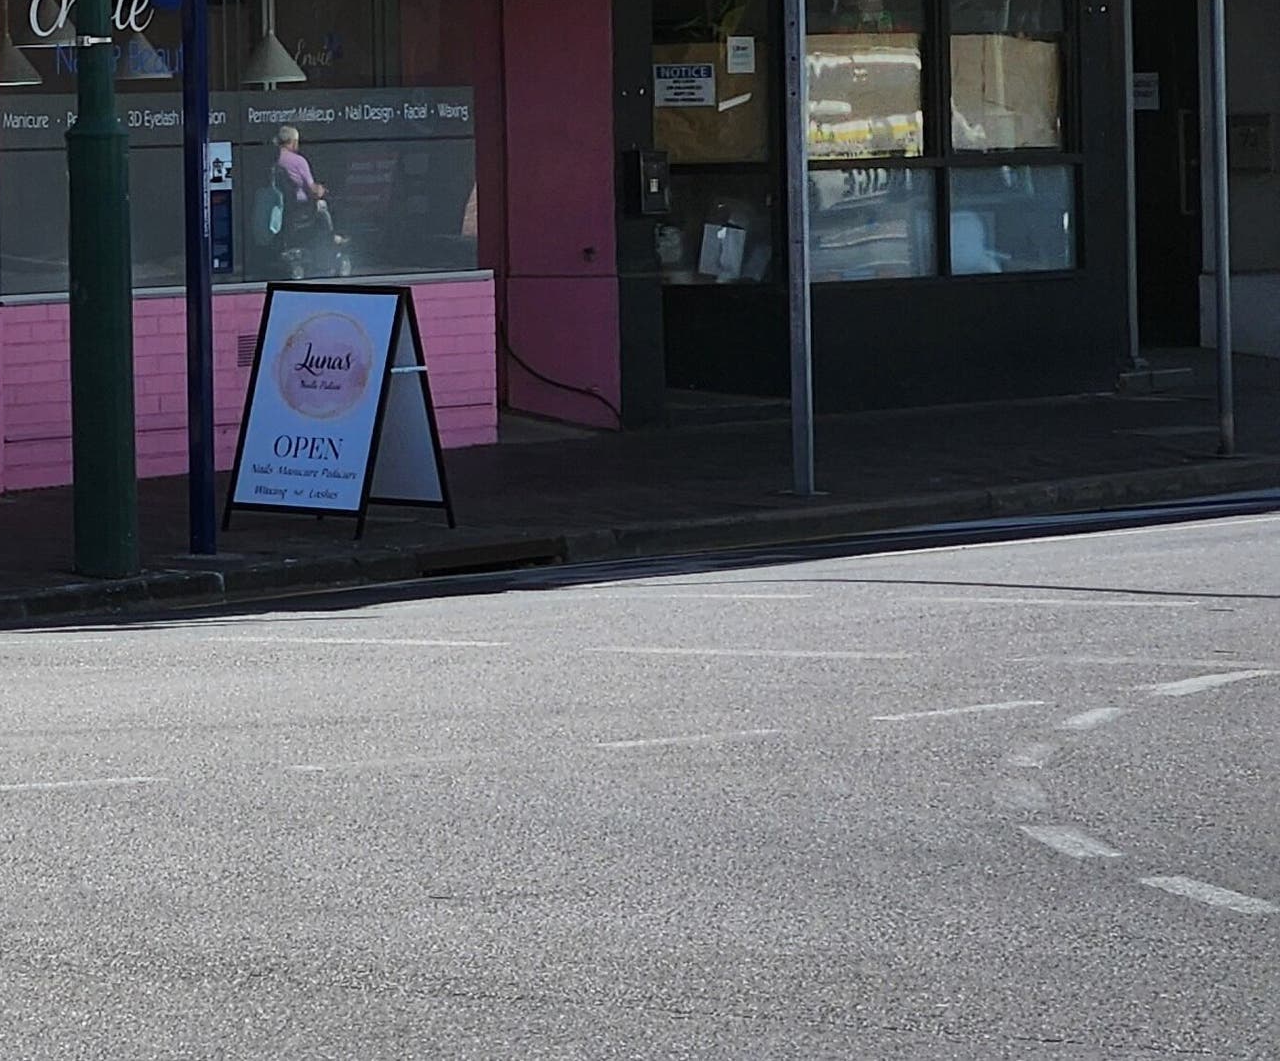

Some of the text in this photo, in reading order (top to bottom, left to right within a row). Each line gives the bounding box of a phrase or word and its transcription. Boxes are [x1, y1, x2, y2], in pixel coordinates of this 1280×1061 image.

[129, 42, 183, 74] Beaut
[660, 66, 710, 78] NOTICE
[3, 111, 49, 129] Manicure
[128, 109, 142, 127] 3D
[144, 109, 179, 130] Eyelash
[345, 105, 361, 121] Nail
[363, 105, 394, 124] Design
[403, 103, 427, 120] Facial
[437, 103, 469, 122] Waxing
[295, 342, 351, 376] Lunas
[274, 435, 343, 461] OPEN
